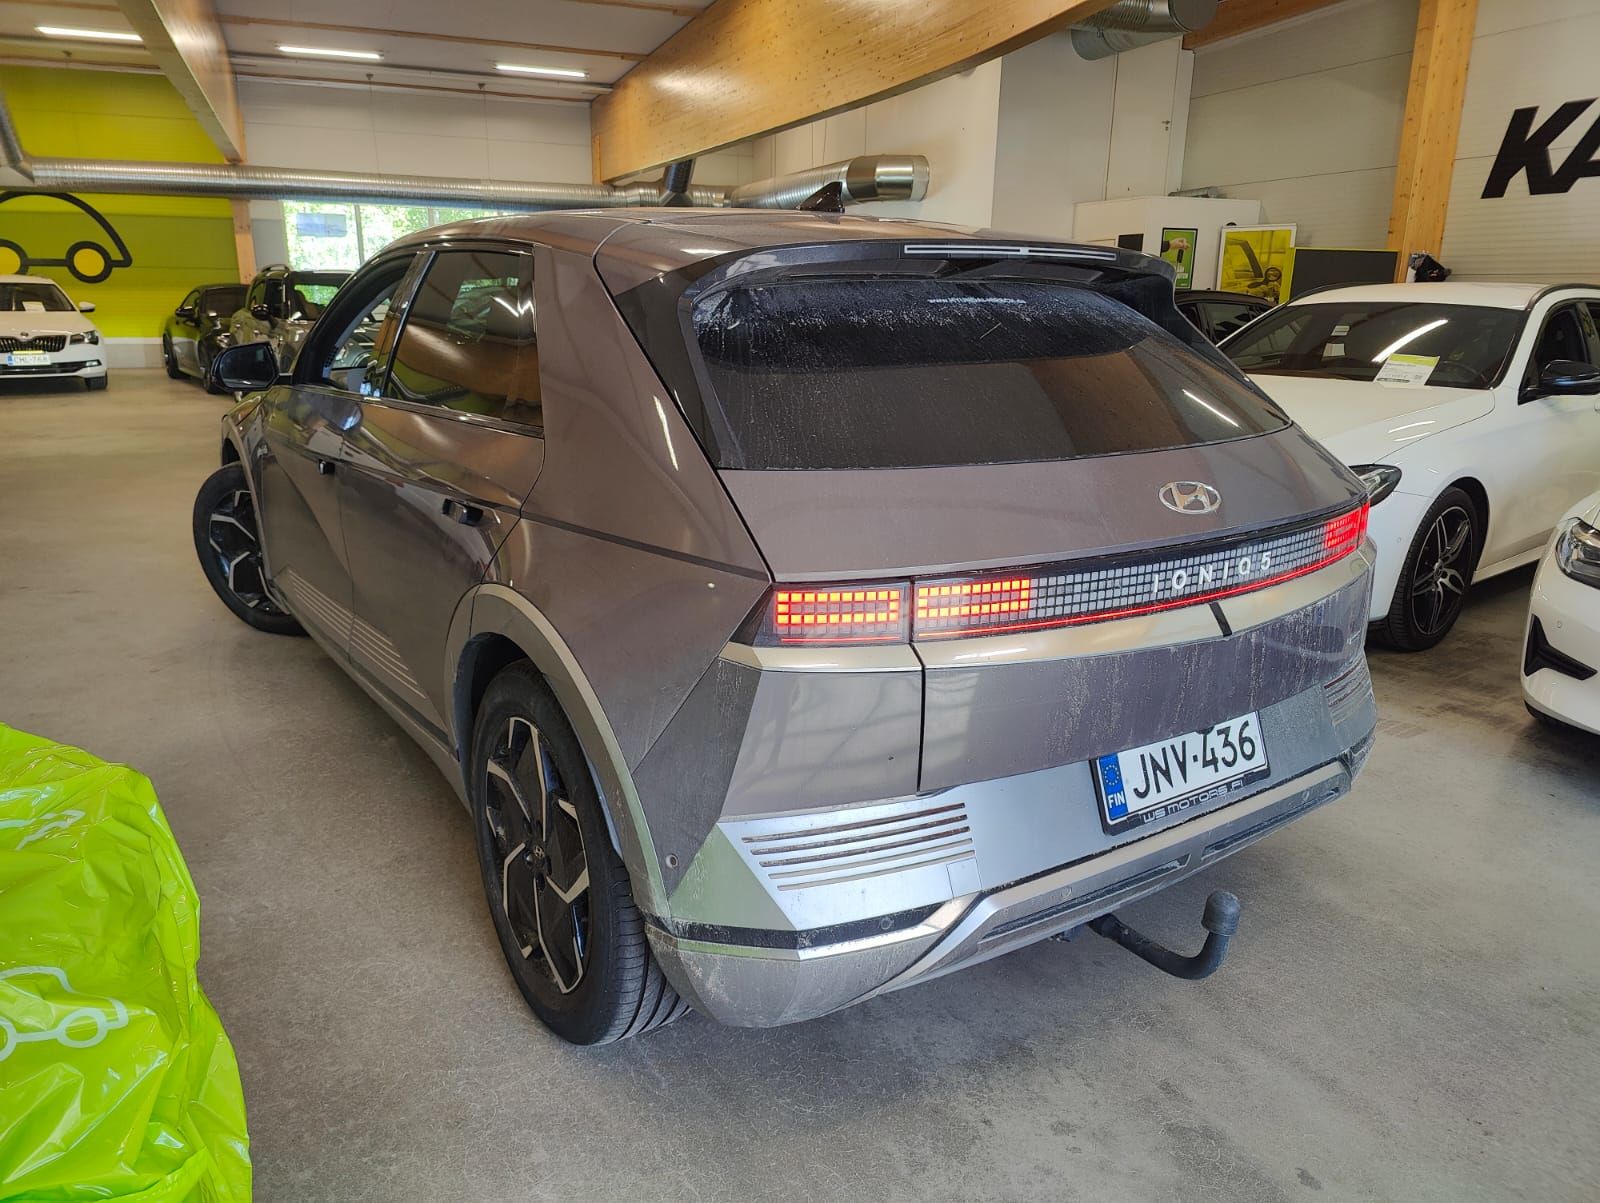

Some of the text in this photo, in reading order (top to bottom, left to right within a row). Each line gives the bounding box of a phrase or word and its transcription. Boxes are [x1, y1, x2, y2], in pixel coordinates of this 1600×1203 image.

[1153, 551, 1272, 593] IONIQ 5
[1107, 791, 1126, 809] FIN
[1143, 806, 1166, 823] WS
